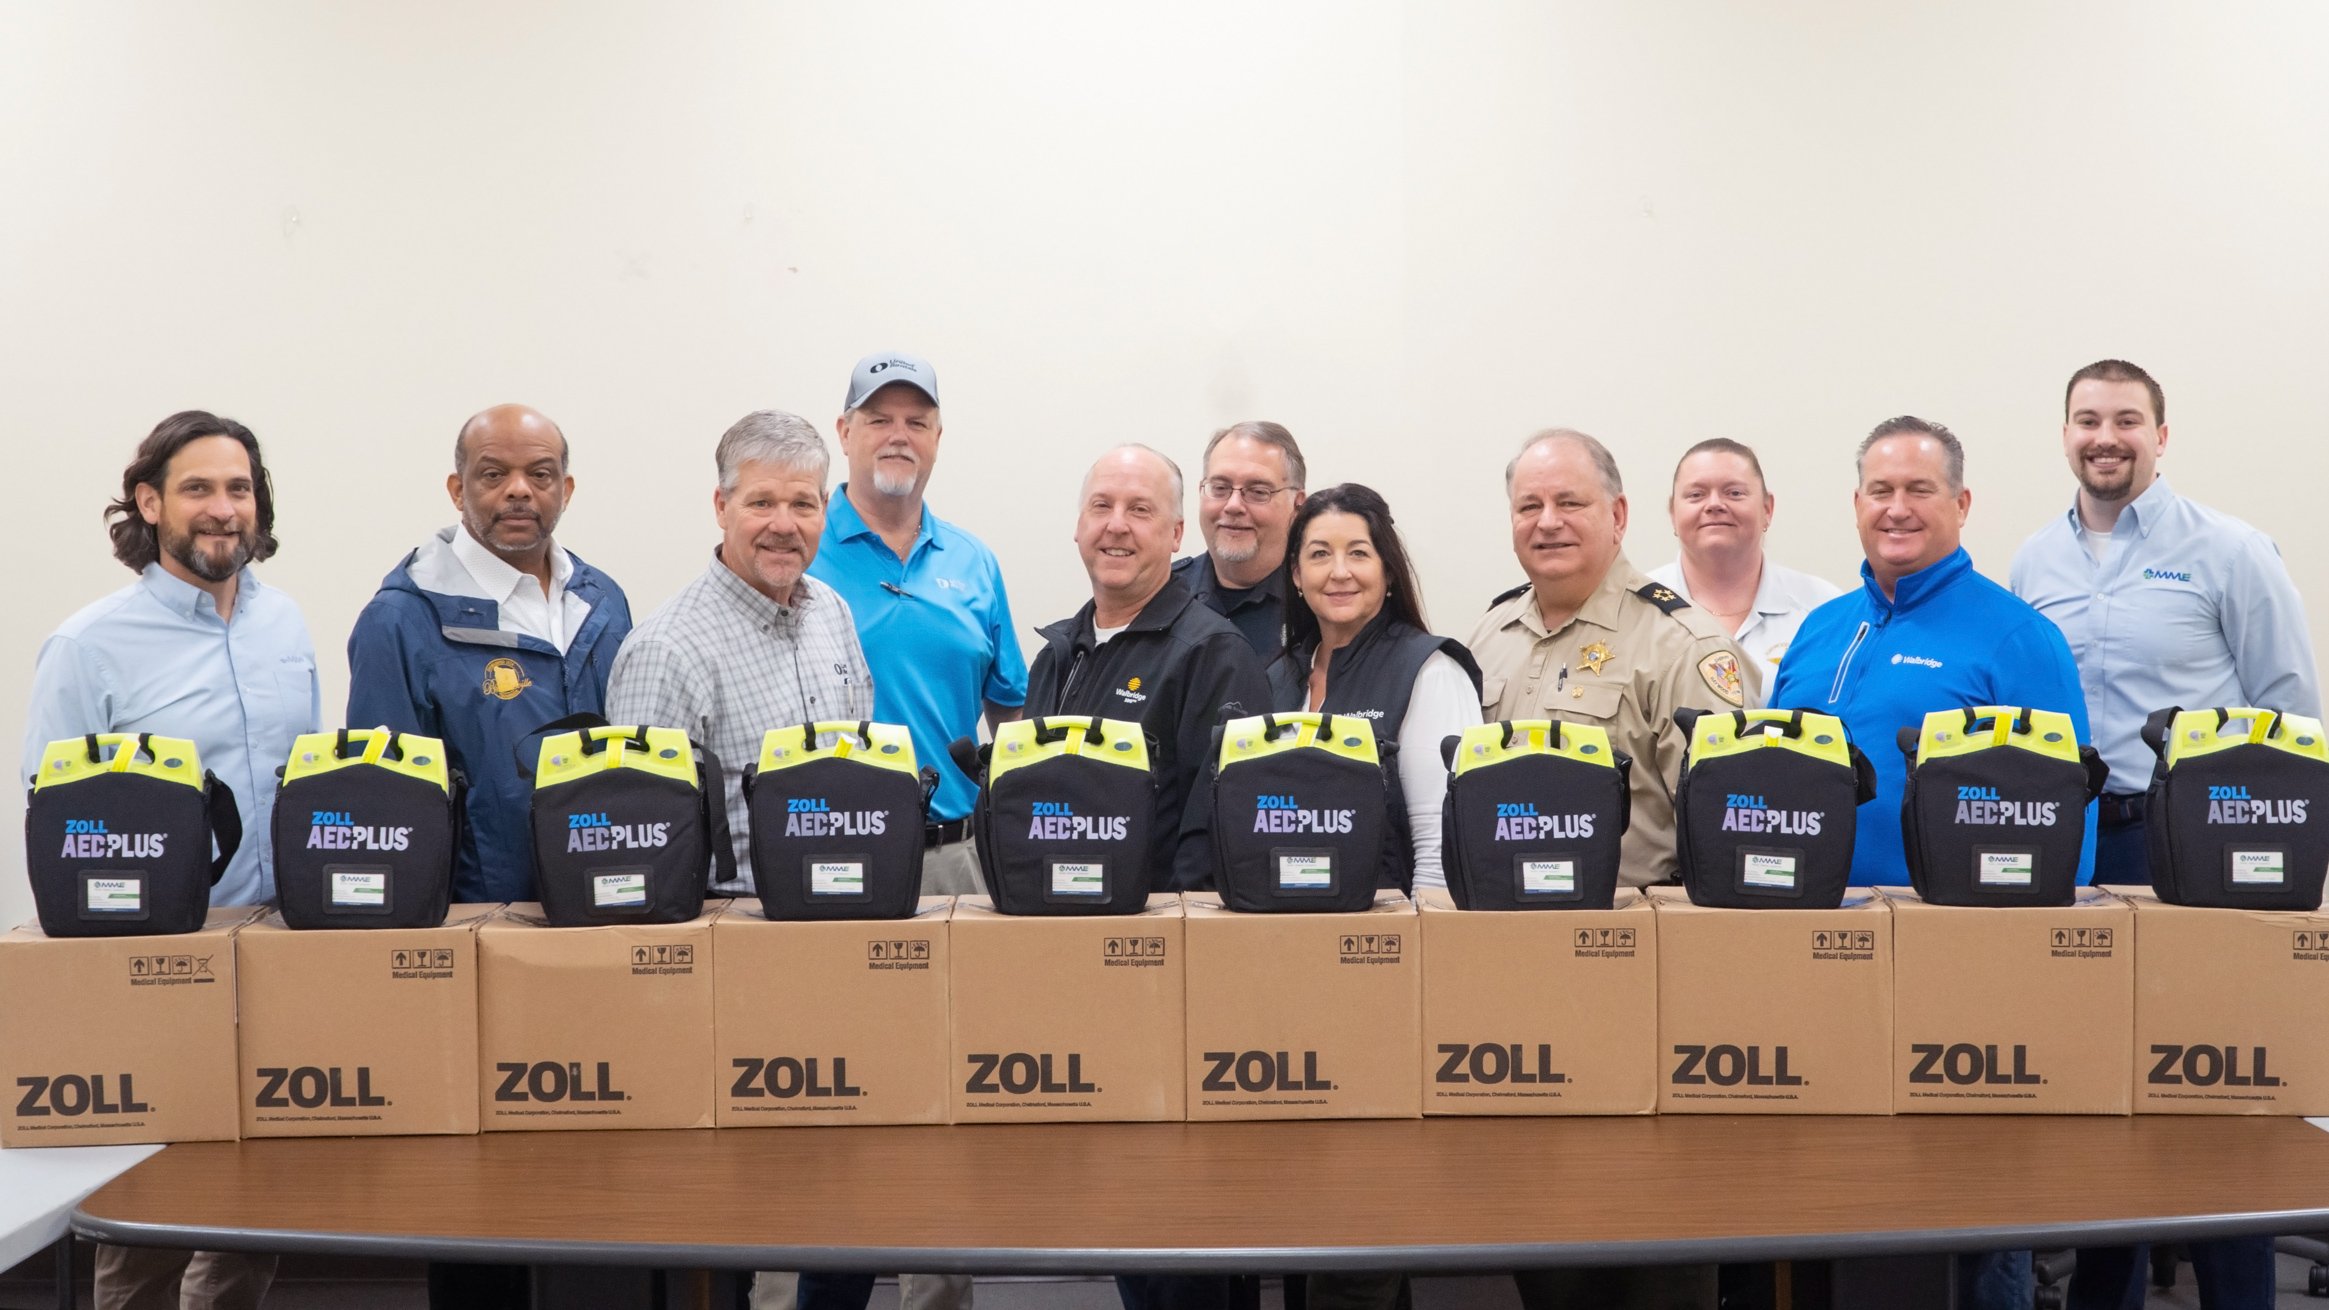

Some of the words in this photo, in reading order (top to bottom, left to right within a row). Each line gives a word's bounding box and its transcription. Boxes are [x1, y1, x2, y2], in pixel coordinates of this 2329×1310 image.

[2154, 569, 2192, 582] MME
[1903, 656, 1943, 669] Walbridge
[1115, 687, 1147, 702] Walbridge
[1958, 786, 2000, 800] ZOLL
[2209, 786, 2250, 800] ZOLL
[787, 799, 830, 813] ZOLL
[1257, 795, 1297, 809] ZOLL
[1728, 794, 1766, 809] ZOLL
[1033, 802, 1072, 816] ZOLL
[1498, 804, 1538, 817] ZOLL
[312, 811, 353, 826] ZOLL
[569, 813, 610, 829] ZOLL
[66, 819, 107, 834] ZOLL
[1367, 956, 1400, 965] Equipment
[1602, 950, 1635, 958] Equipment
[1840, 952, 1873, 961] Equipment
[2078, 950, 2112, 959] Equipment
[896, 963, 929, 971] Equipment
[1131, 959, 1164, 967] Equipment
[419, 971, 453, 980] Equipment
[659, 967, 692, 975] Equipment
[157, 977, 191, 986] Equipment
[1436, 1043, 1565, 1084] ZOLL
[1672, 1045, 1802, 1086] ZOLL
[1910, 1043, 2040, 1085] ZOLL
[2148, 1045, 2280, 1086] ZOLL
[731, 1057, 860, 1098] ZOLL
[966, 1053, 1095, 1094] ZOLL
[1202, 1051, 1331, 1092] ZOLL
[256, 1067, 385, 1108] ZOLL
[495, 1062, 624, 1102] ZOLL
[17, 1074, 148, 1116] ZOLL
